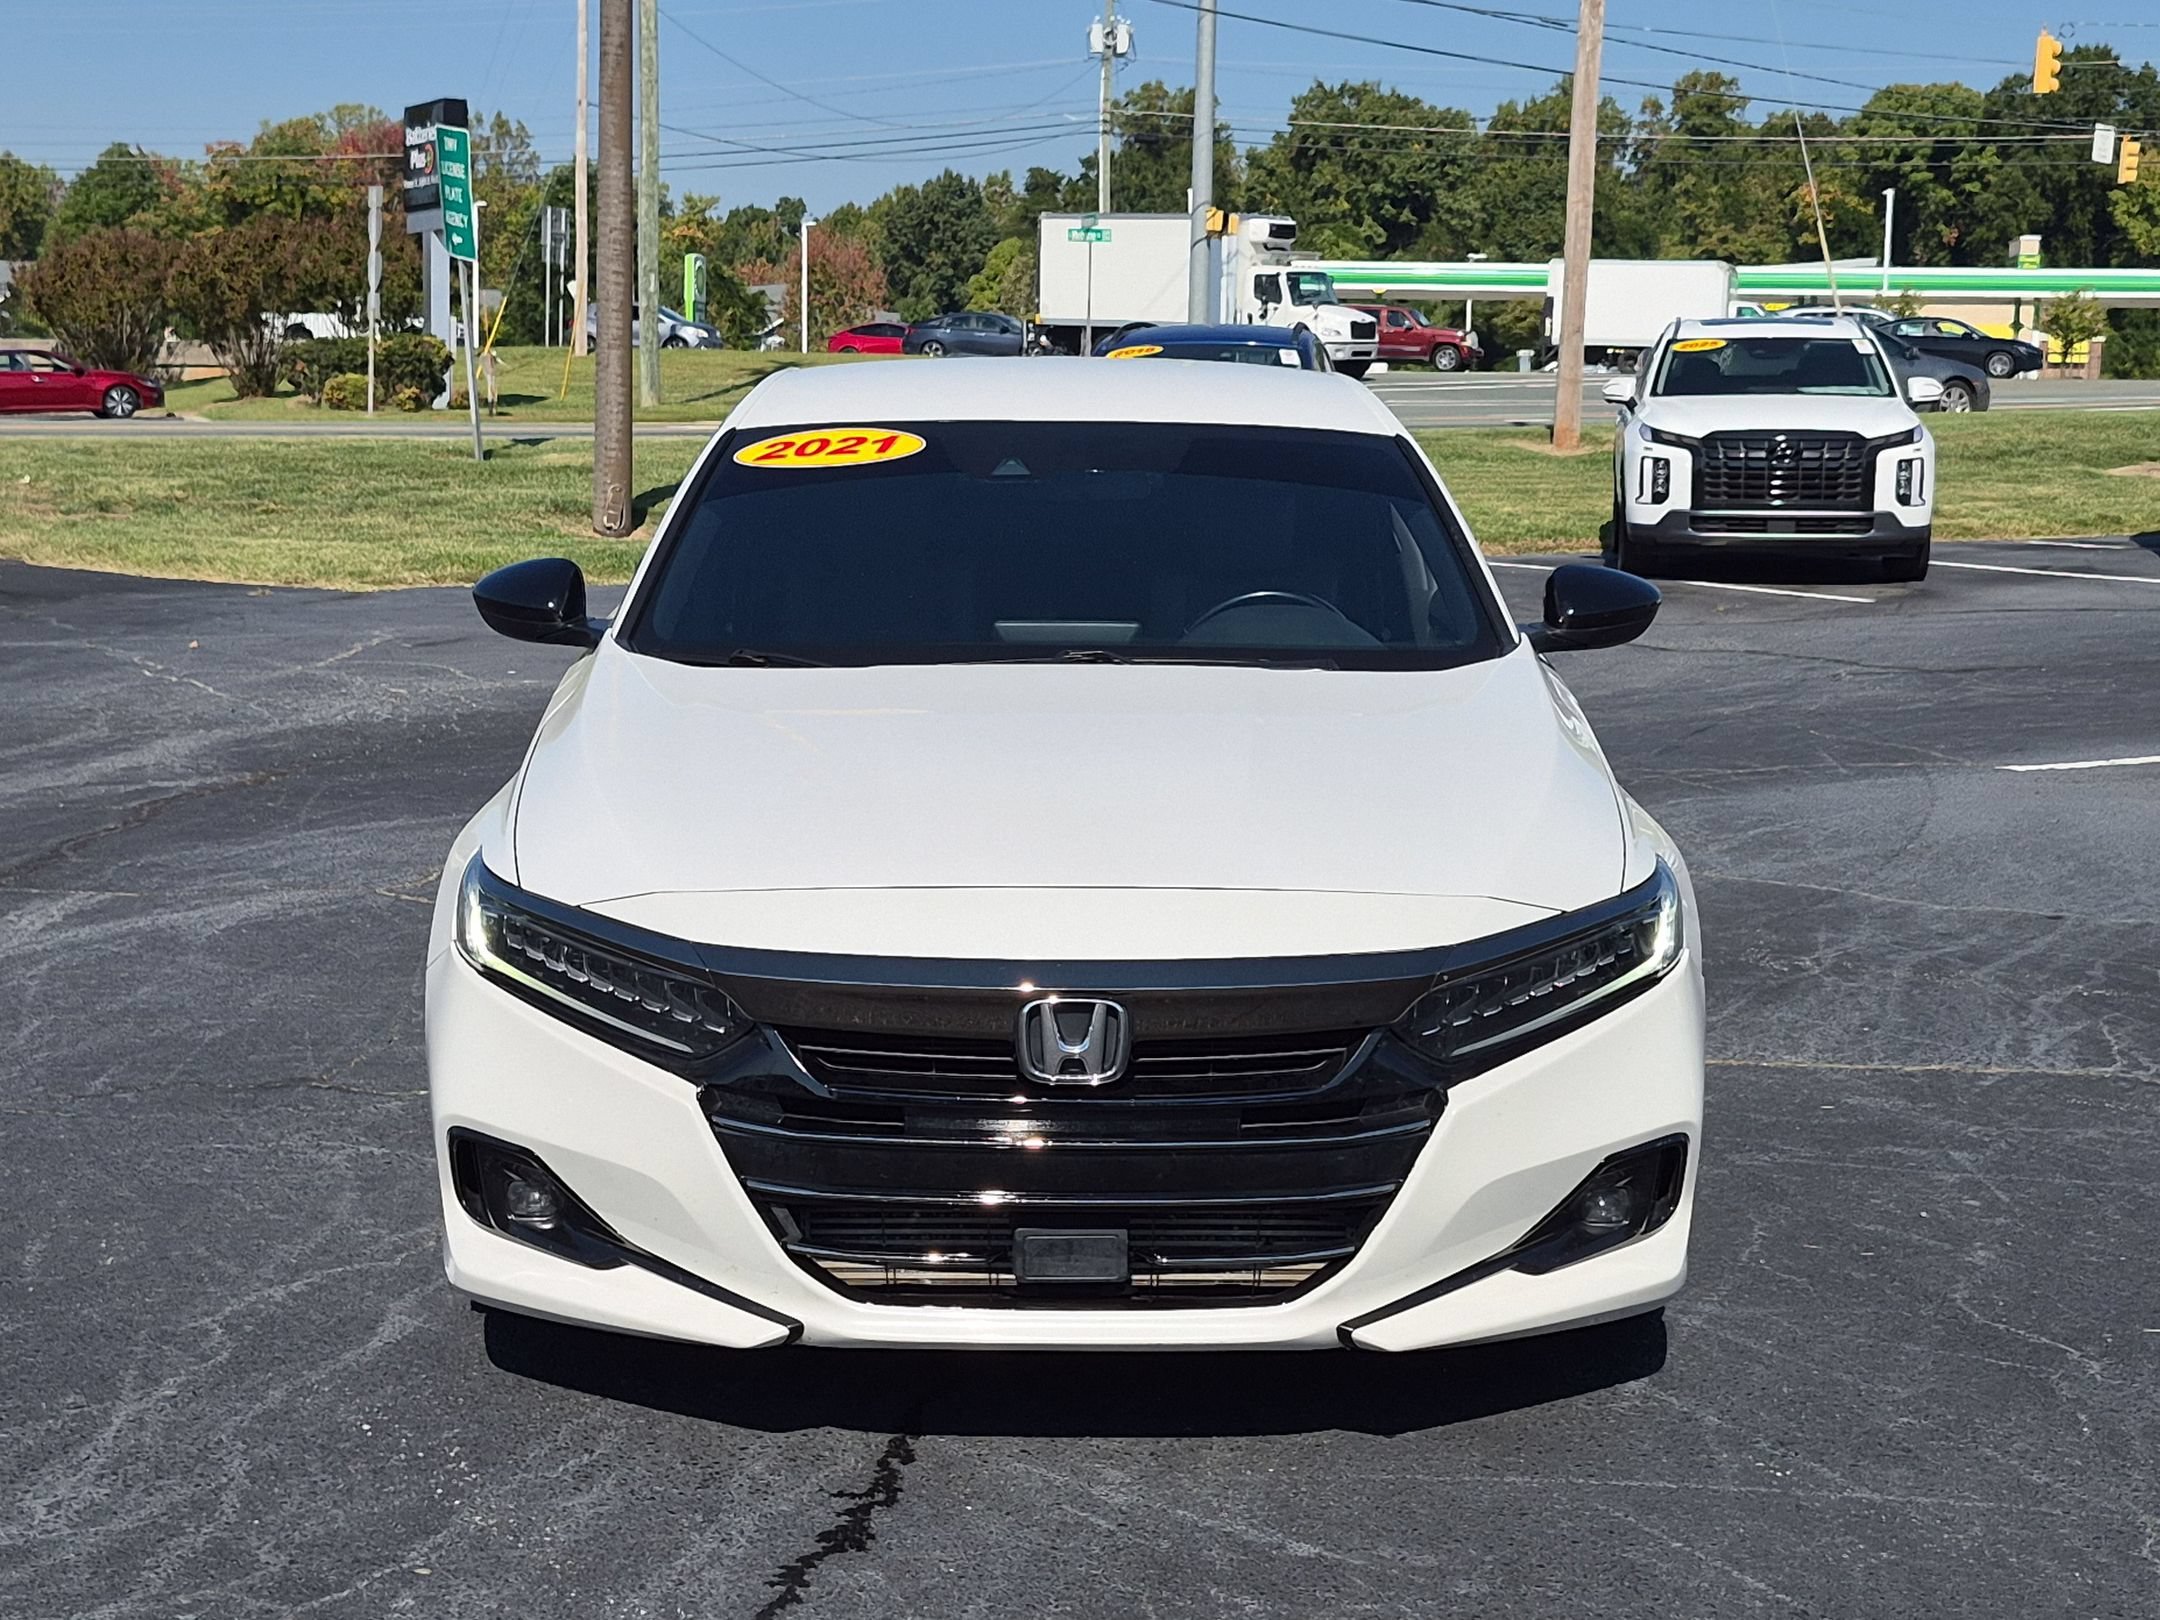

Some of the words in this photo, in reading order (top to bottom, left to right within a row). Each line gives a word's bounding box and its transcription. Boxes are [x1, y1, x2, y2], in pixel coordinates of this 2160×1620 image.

[441, 160, 466, 180] LICENSE
[444, 184, 463, 204] PLATE
[445, 209, 469, 229] AGENCY
[752, 435, 899, 461] 2021
